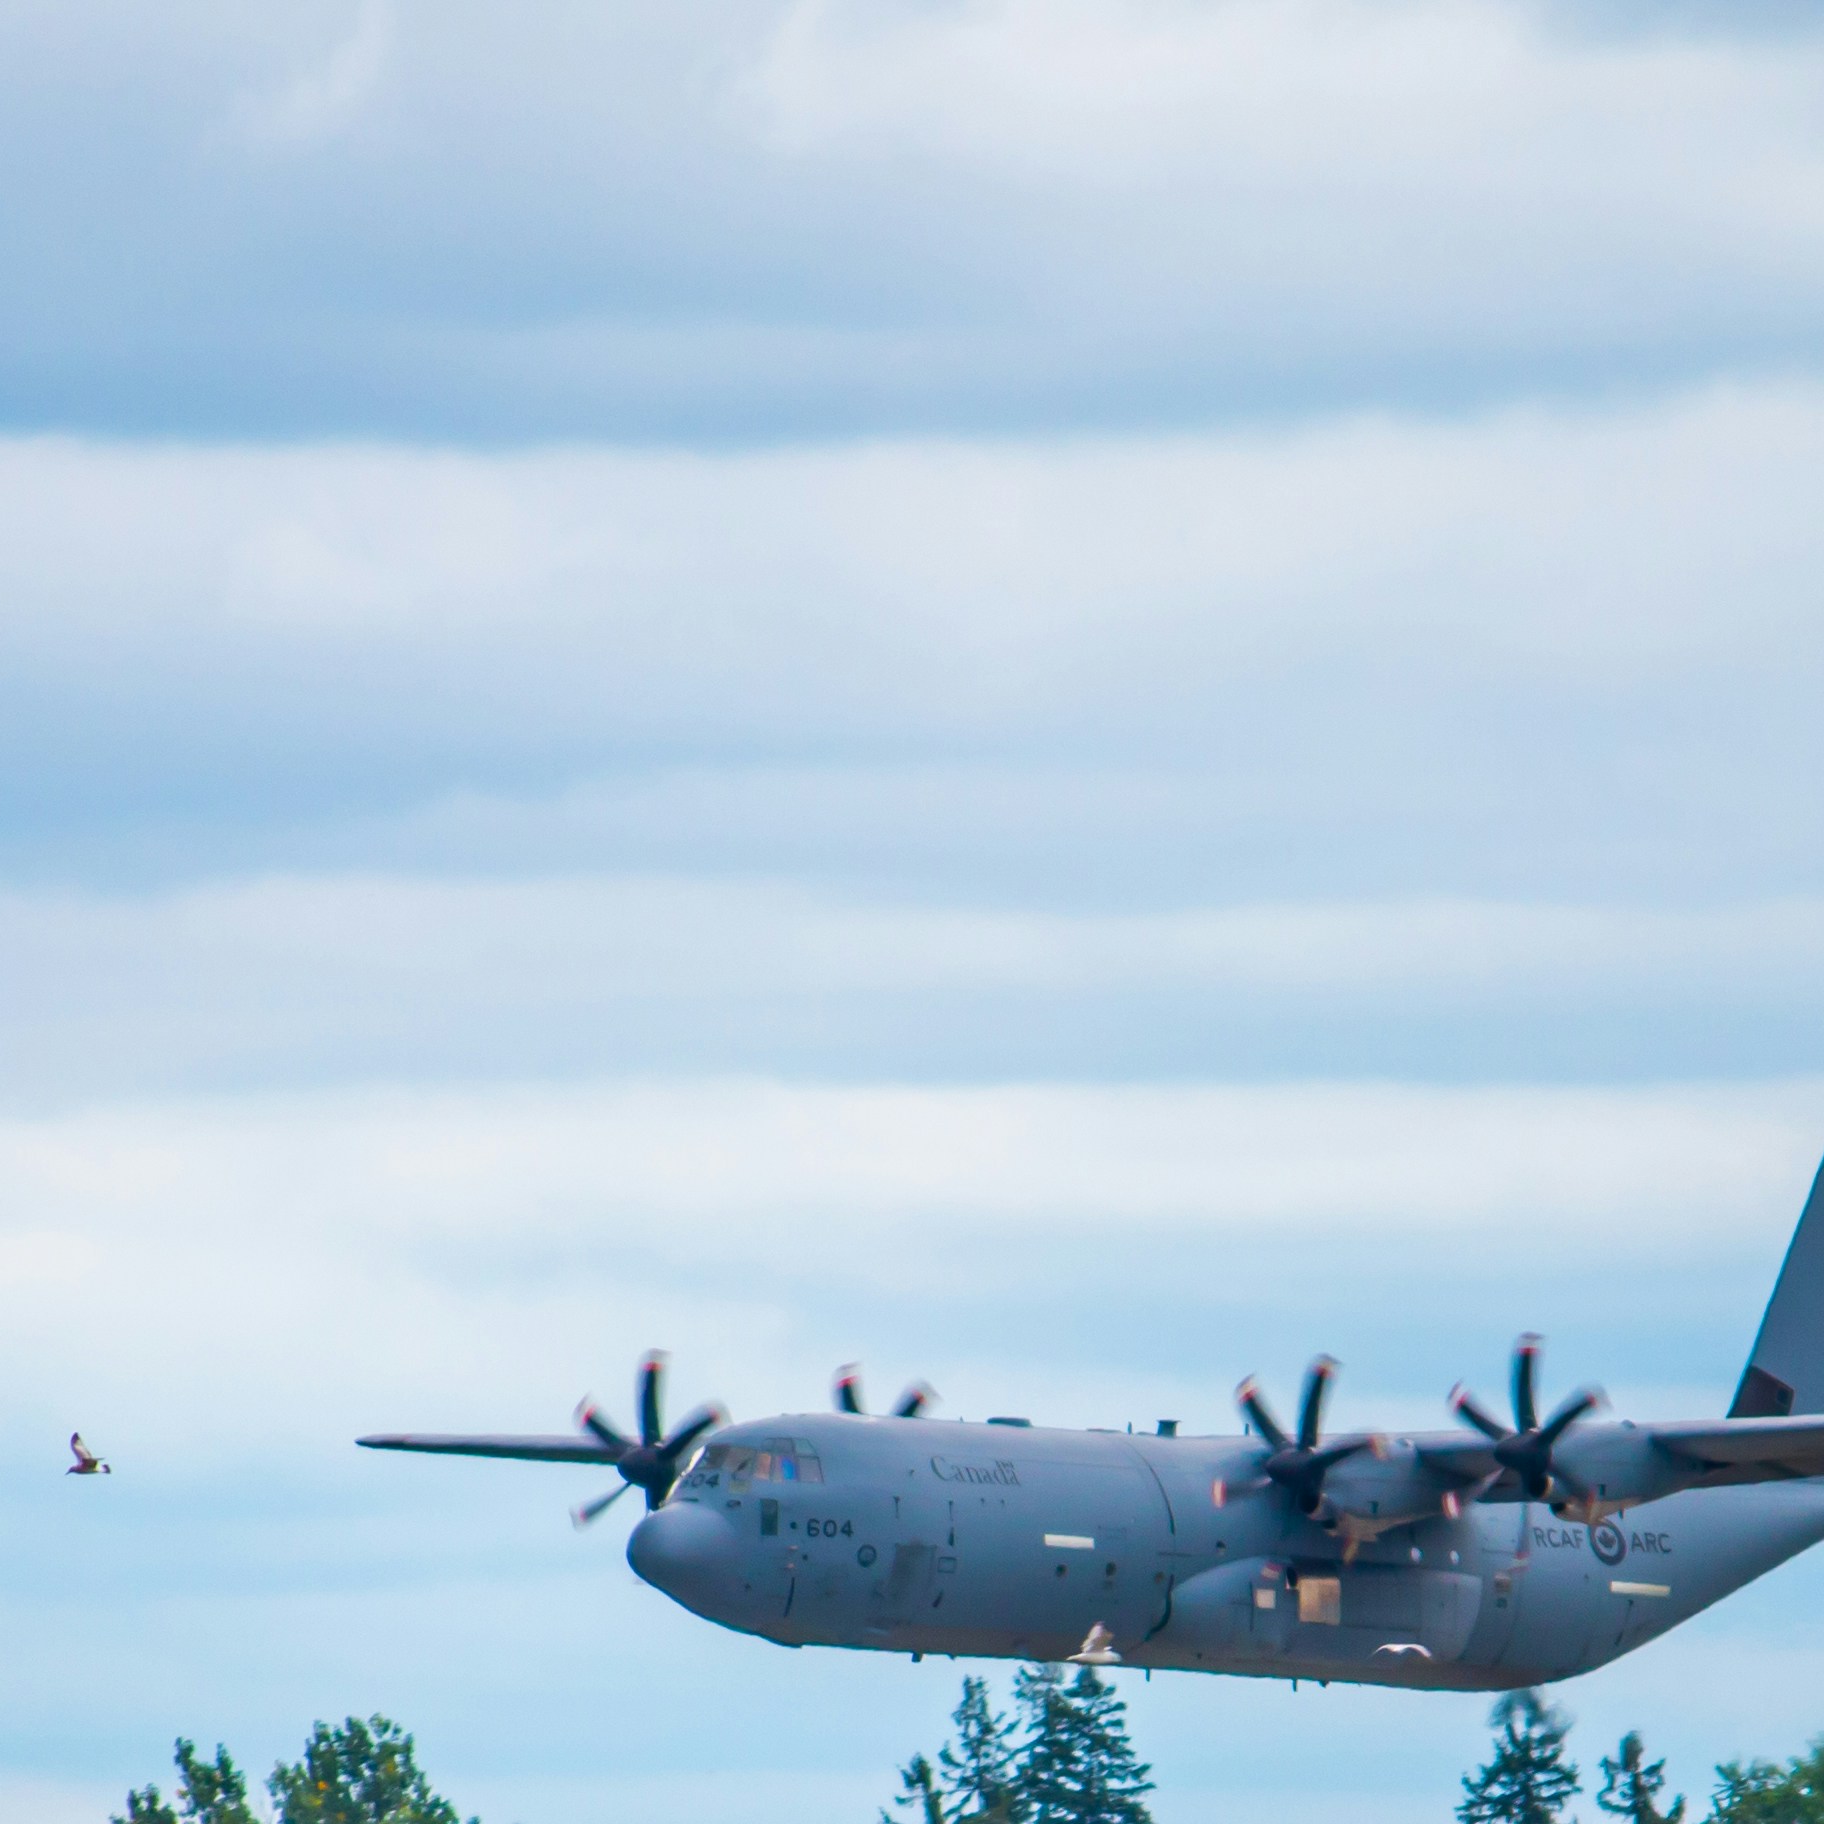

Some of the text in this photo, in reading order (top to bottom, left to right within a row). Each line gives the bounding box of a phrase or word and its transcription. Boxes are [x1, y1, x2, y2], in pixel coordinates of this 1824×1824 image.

[806, 1518, 854, 1538] 604
[1532, 1526, 1672, 1554] RCAF ARC
